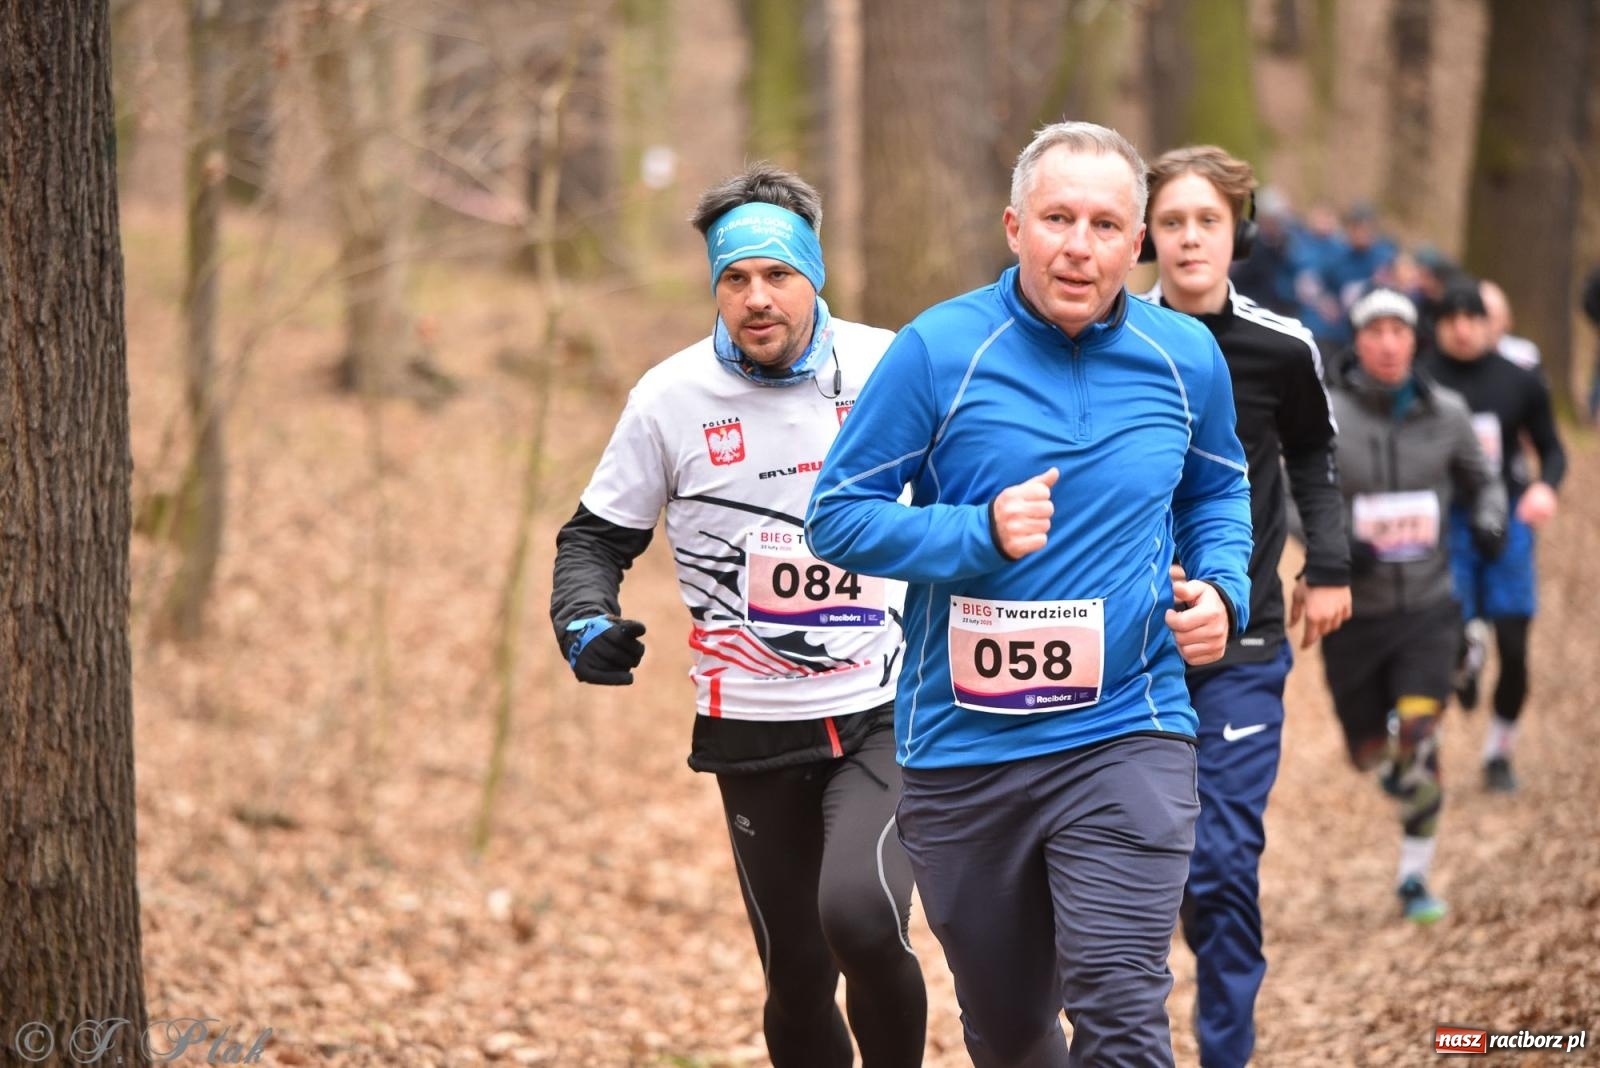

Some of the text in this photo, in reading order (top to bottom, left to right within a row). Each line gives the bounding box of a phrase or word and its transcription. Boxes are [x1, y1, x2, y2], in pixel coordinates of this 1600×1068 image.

[702, 416, 741, 429] POLSKA
[760, 532, 792, 543] BIEG
[772, 562, 861, 601] 084
[829, 613, 861, 623] Racibórz
[962, 603, 1088, 620] BIEG Twardziela
[974, 638, 1073, 681] 058
[1036, 694, 1072, 704] Racibórz
